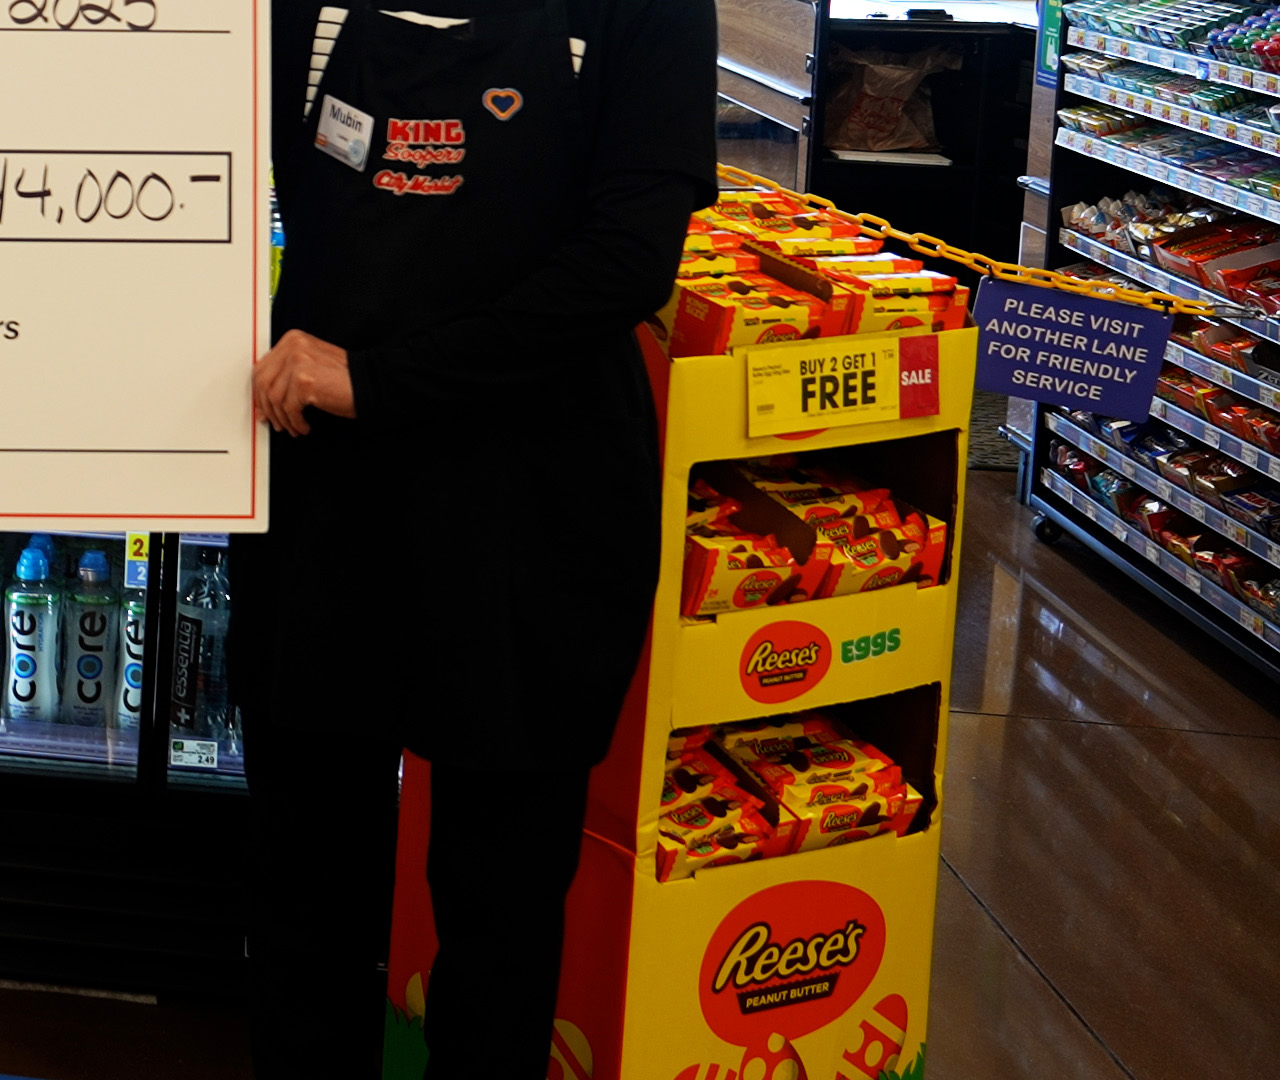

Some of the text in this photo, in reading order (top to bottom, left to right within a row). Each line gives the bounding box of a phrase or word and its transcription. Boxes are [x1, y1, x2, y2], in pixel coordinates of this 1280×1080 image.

[329, 104, 363, 133] Mubin
[386, 118, 466, 145] KING
[382, 141, 467, 169] Soopers
[1003, 296, 1144, 339] PLEASE VISIT
[985, 317, 1149, 364] ANOTHER LANE
[800, 357, 826, 377] BUY
[829, 356, 839, 373] 2
[841, 353, 866, 371] GET
[870, 351, 876, 368] 1
[900, 368, 933, 387] SALE
[987, 340, 1138, 385] FOR FRIENDLY
[800, 369, 877, 414] FREE
[1011, 368, 1103, 402] SERVICE
[11, 605, 38, 704] core
[77, 609, 107, 705] core
[173, 620, 193, 700] essentia
[746, 628, 902, 675] Reese's EGGS
[761, 672, 805, 685] PEANUT BUTTER
[196, 754, 215, 766] 2.49
[711, 920, 867, 994] Reese's
[745, 981, 830, 1009] PEANUT BUTTER
